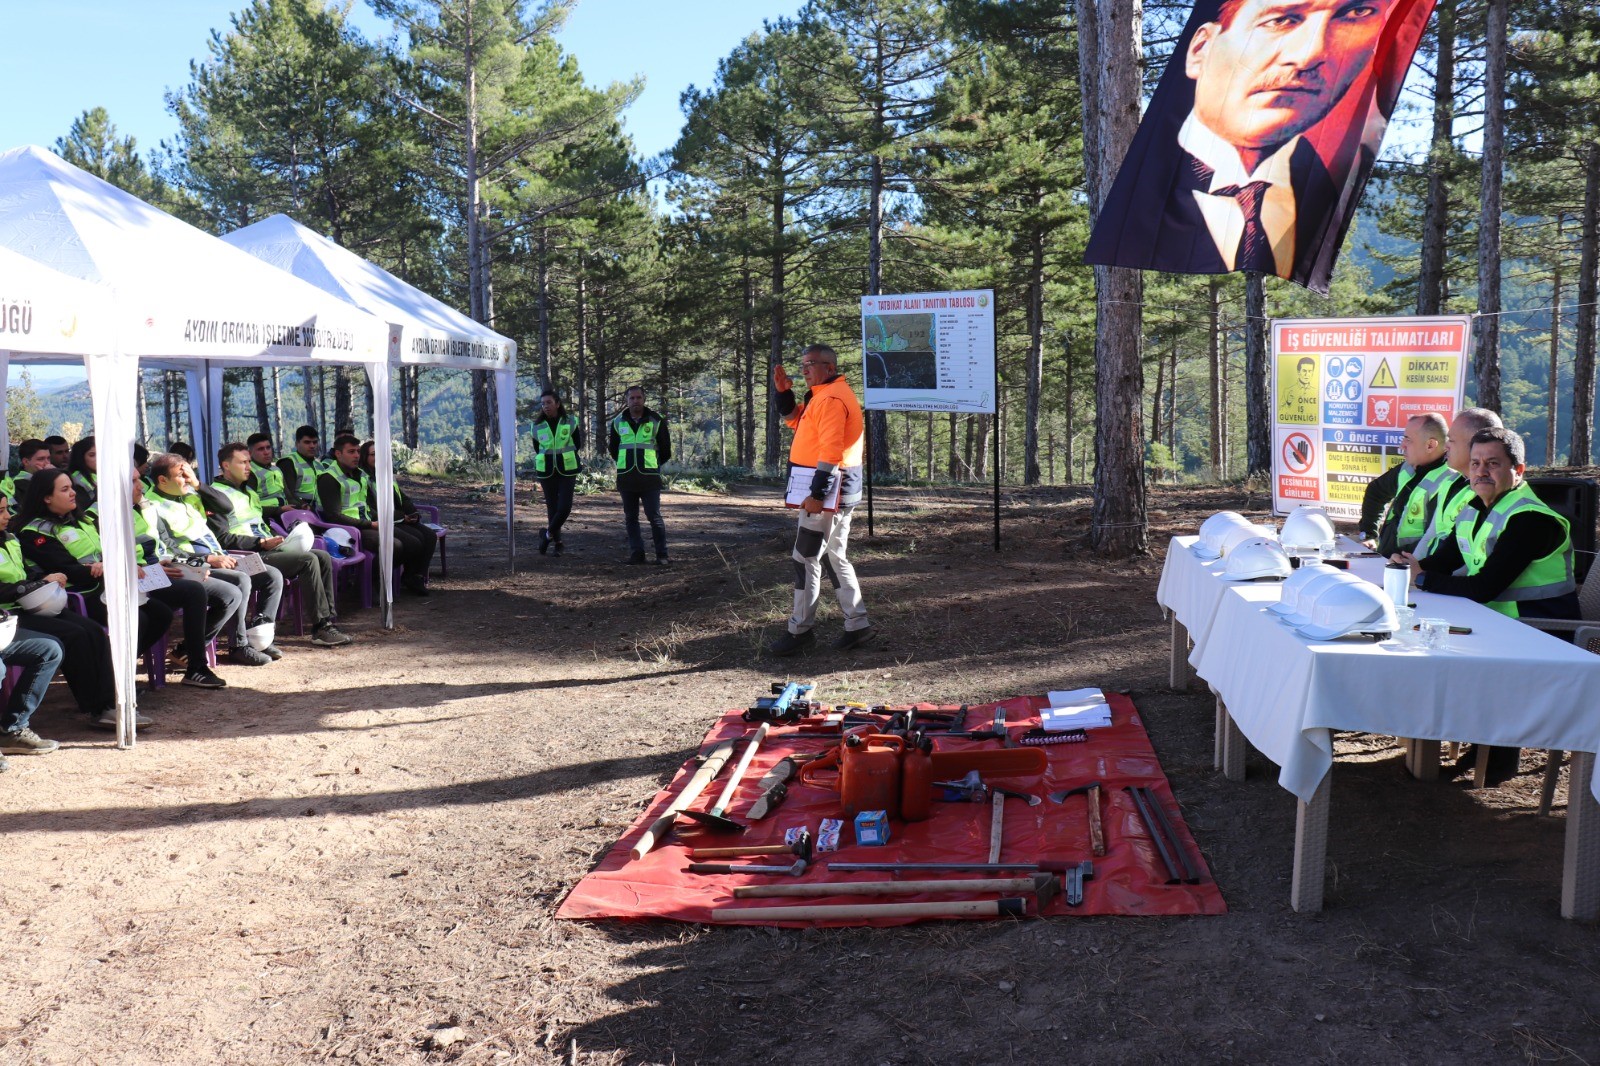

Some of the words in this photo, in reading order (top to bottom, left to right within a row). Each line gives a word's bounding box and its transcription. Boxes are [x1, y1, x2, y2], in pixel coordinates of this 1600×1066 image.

[923, 298, 947, 309] TANITIM
[949, 297, 975, 308] TABLOSU
[184, 319, 218, 343] AYDIN
[221, 321, 259, 345] ORMAN
[1287, 330, 1299, 350] İŞ
[1302, 328, 1367, 348] GÜVENLİĞİ
[1371, 327, 1454, 347] TALİMATLARI
[411, 337, 430, 354] AYDIN
[1408, 359, 1449, 371] DİKKAT!
[1426, 374, 1449, 384] SAHASI
[1349, 431, 1379, 443] ÖNCE
[1337, 444, 1372, 453] UYARI
